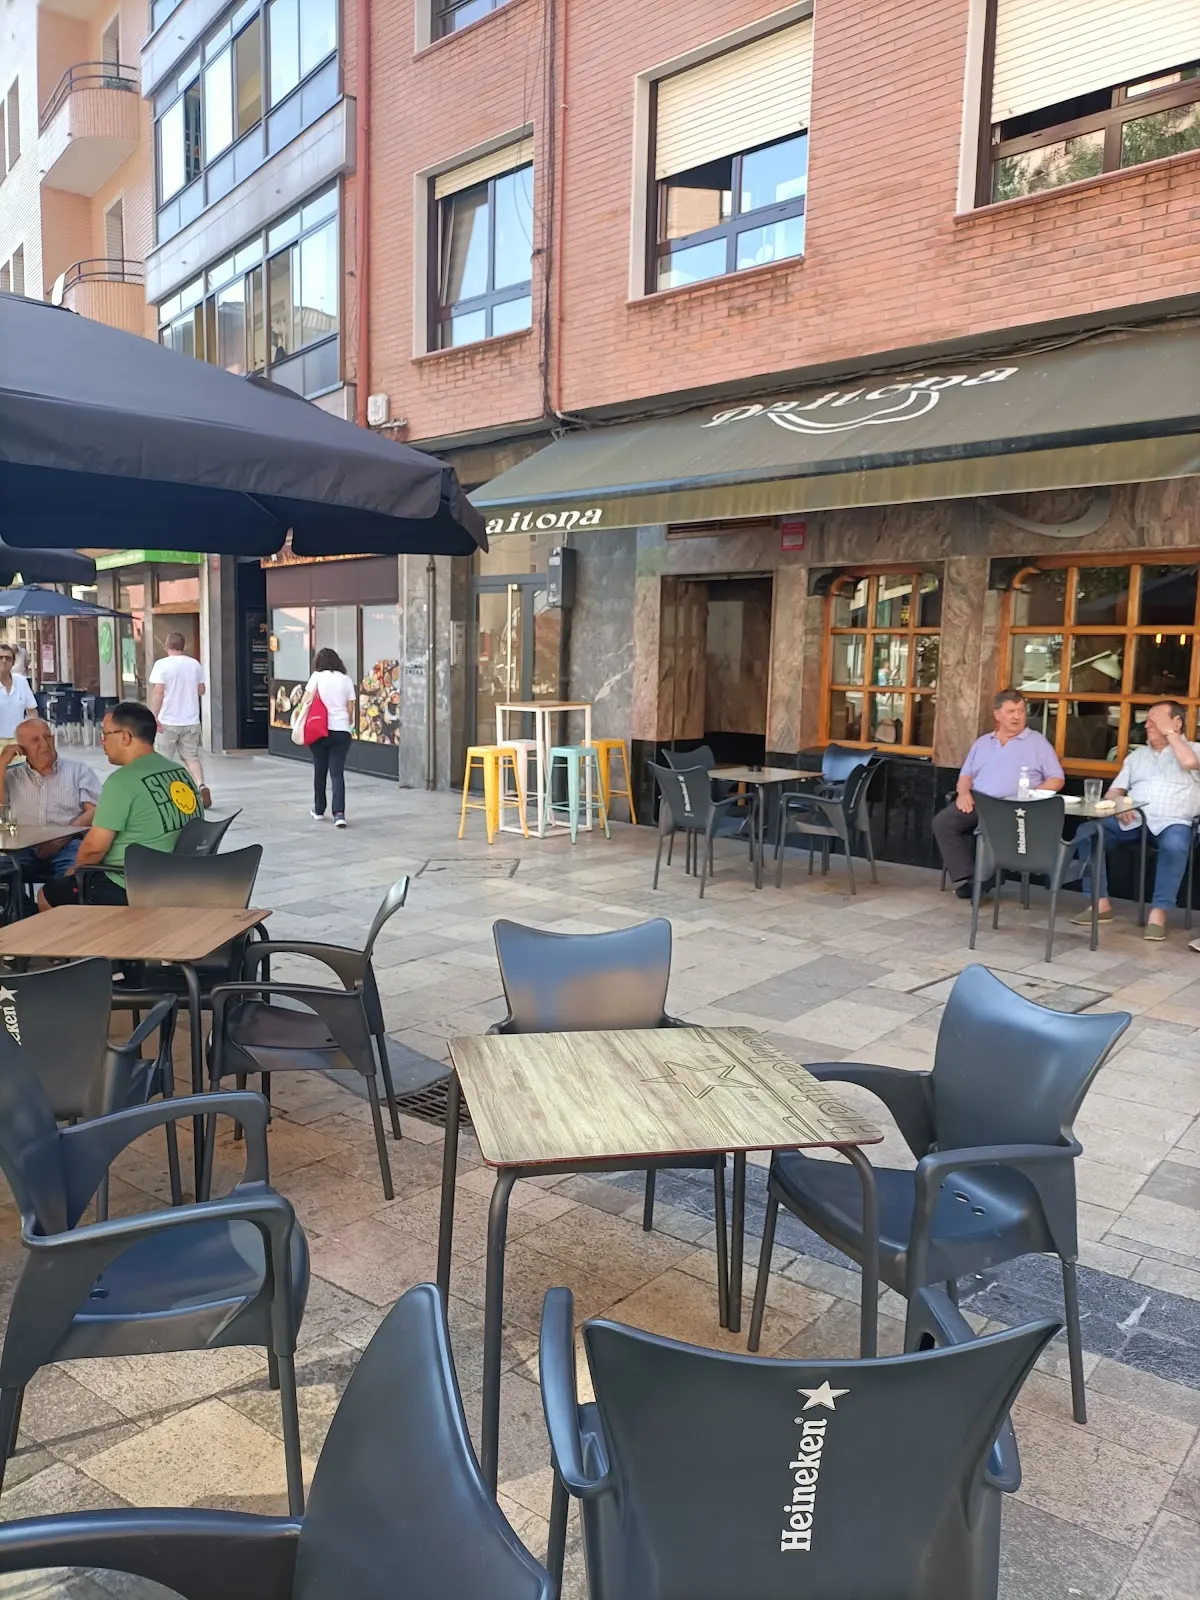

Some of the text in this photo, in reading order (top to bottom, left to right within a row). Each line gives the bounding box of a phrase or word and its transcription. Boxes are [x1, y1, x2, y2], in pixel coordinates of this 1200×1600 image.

[485, 508, 603, 535] aitona
[1016, 817, 1027, 854] Heineken
[781, 1417, 828, 1552] Heineken
